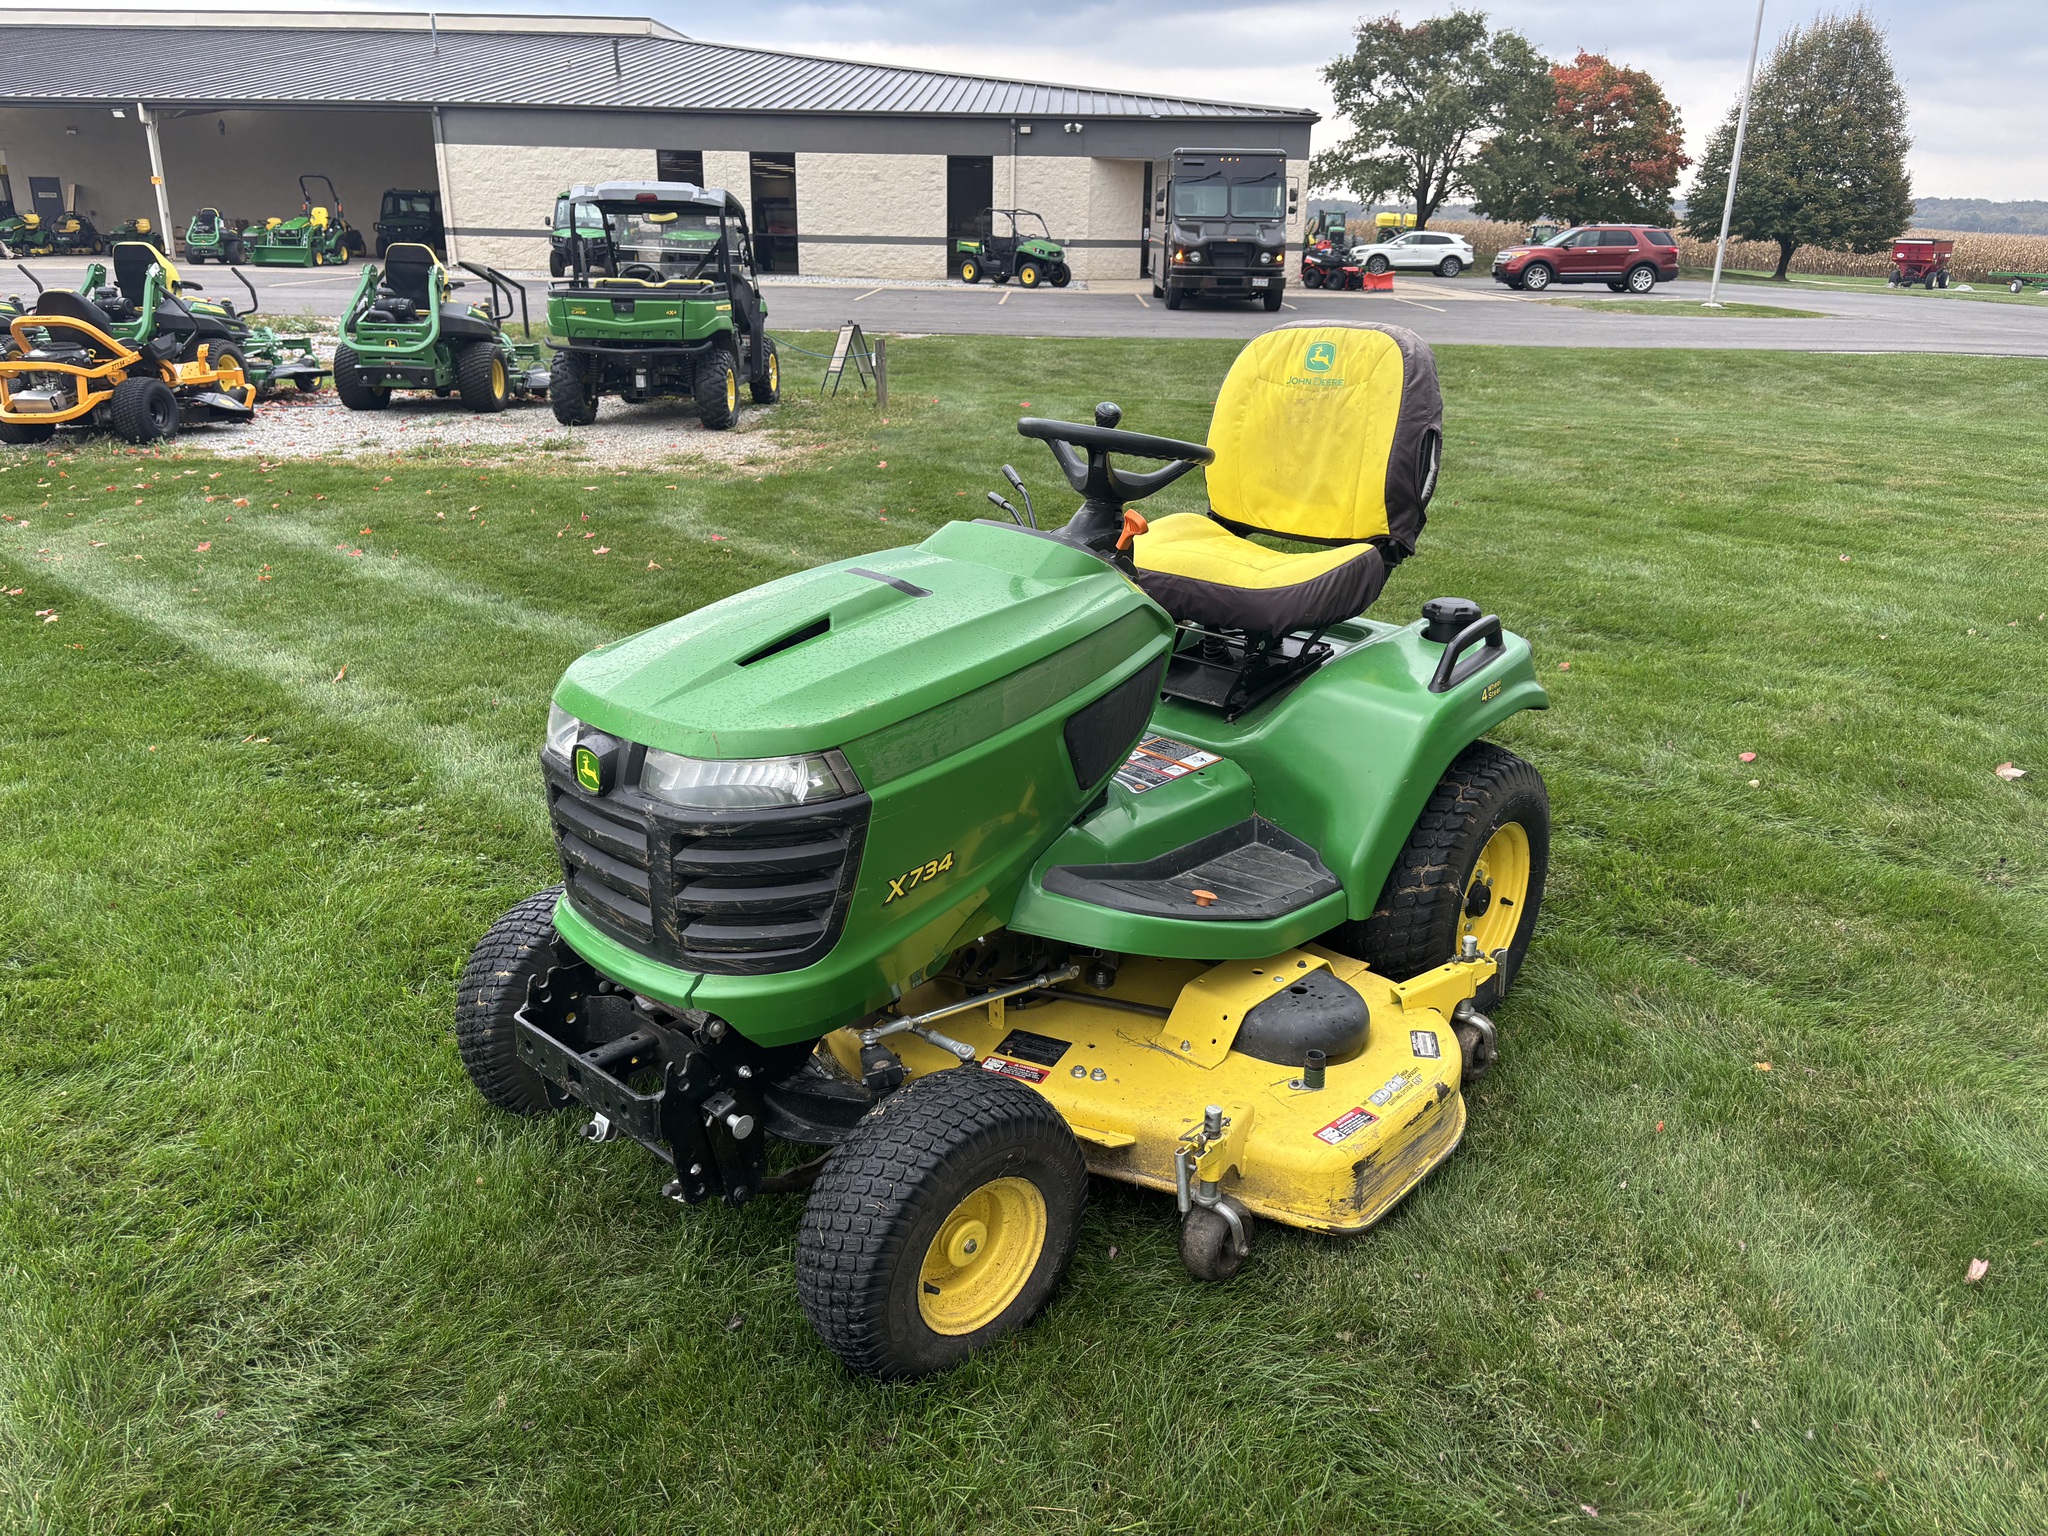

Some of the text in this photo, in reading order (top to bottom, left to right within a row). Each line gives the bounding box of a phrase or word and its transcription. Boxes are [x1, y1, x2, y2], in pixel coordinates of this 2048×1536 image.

[1286, 376, 1345, 387] JOHN DEERE
[1481, 688, 1488, 702] 4
[882, 850, 954, 906] X734
[1367, 1072, 1410, 1108] EDGE
